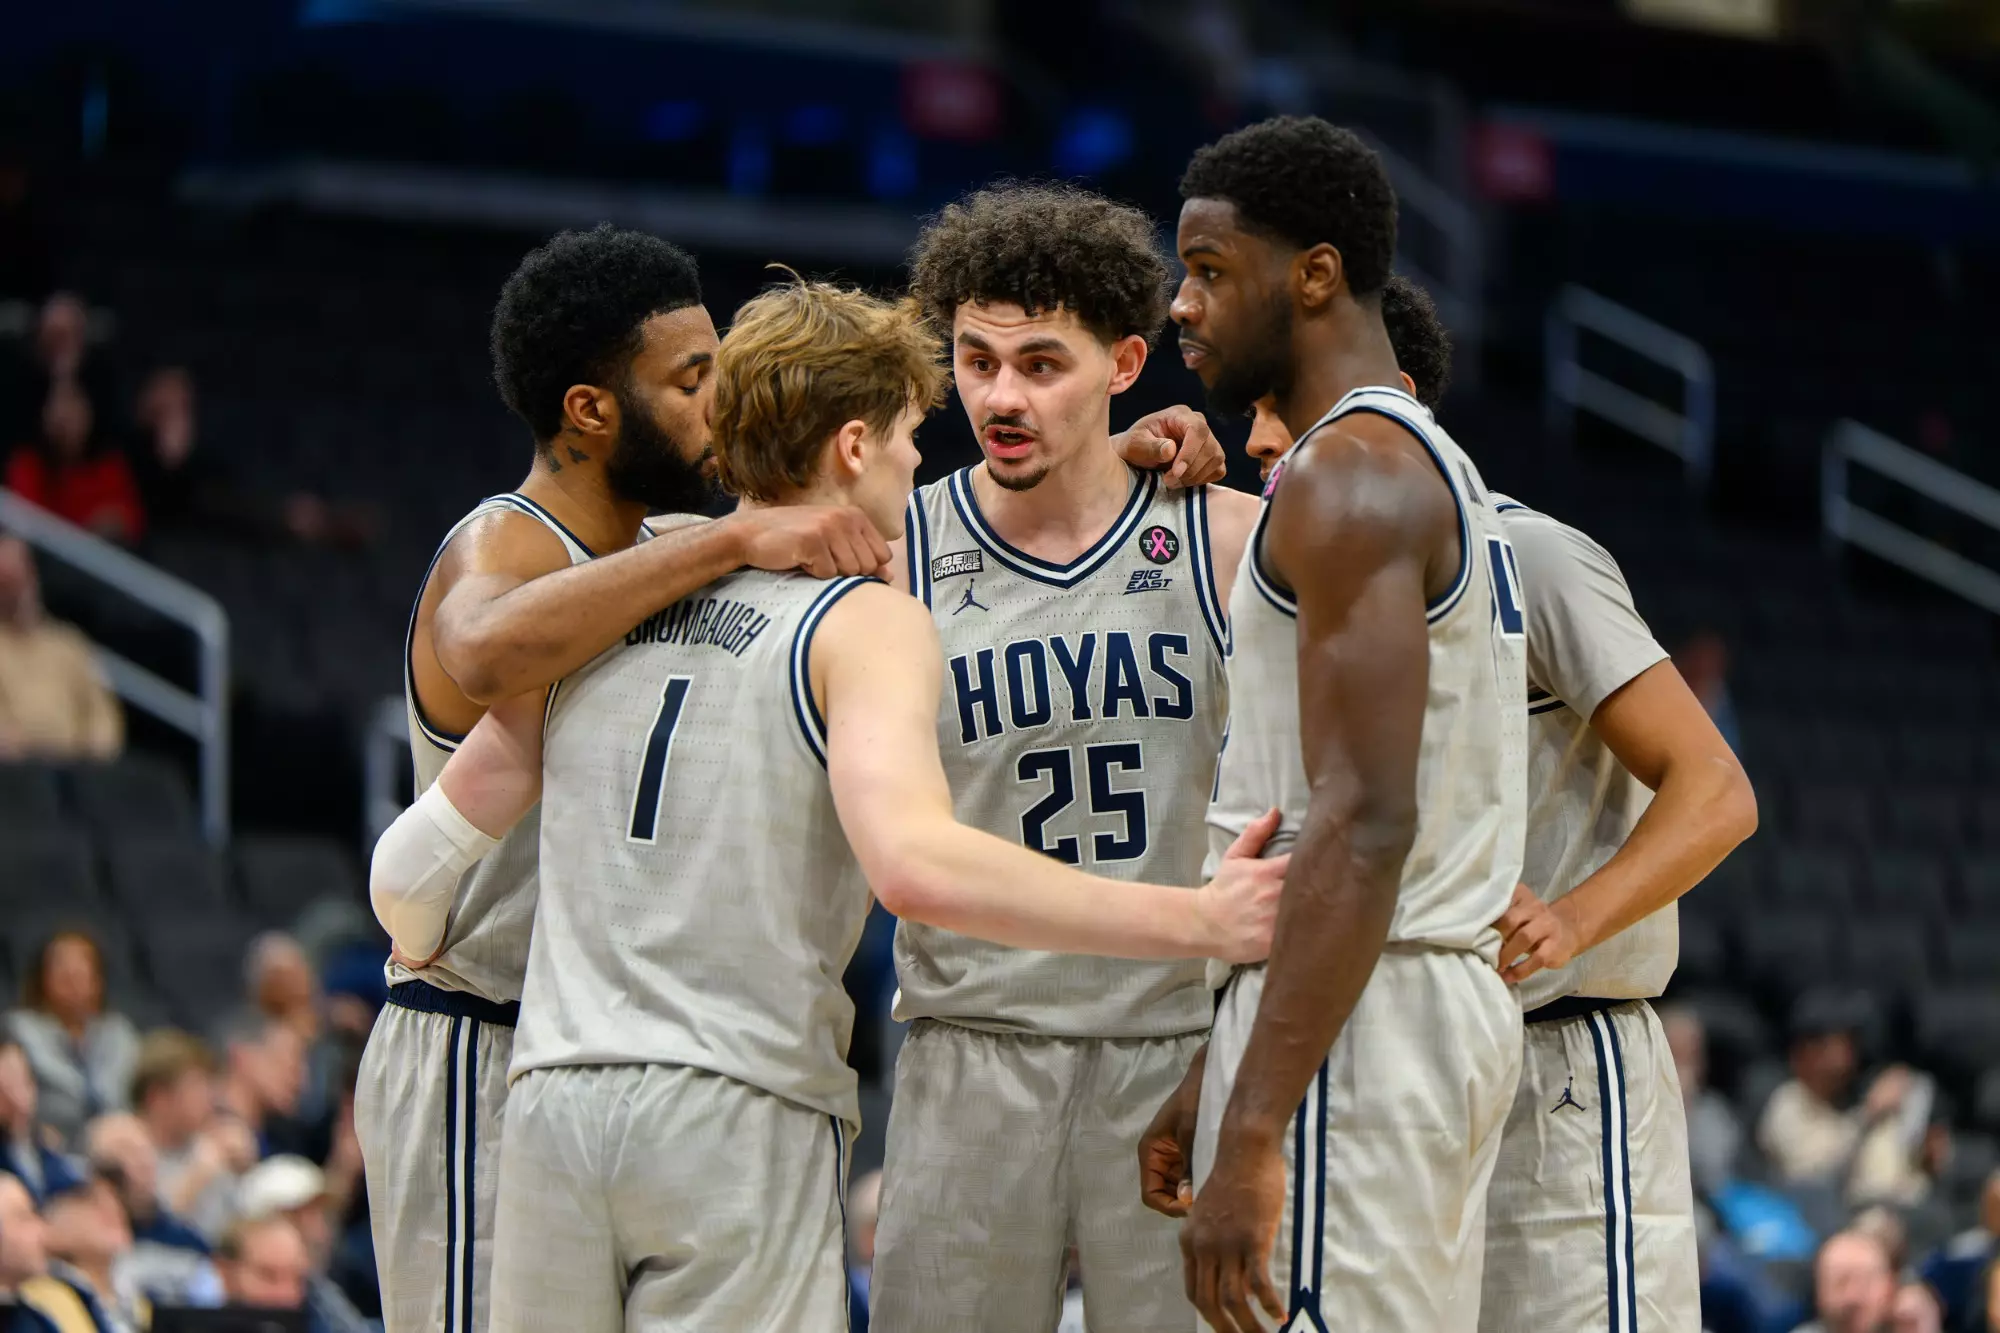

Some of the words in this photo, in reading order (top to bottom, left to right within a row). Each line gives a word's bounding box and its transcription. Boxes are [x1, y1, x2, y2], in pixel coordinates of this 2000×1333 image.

[934, 562, 980, 578] CHANGE
[1126, 579, 1173, 590] EAST
[1130, 570, 1163, 580] BIG
[949, 631, 1195, 746] HOYAS
[626, 674, 695, 845] 1
[1015, 740, 1149, 866] 25
